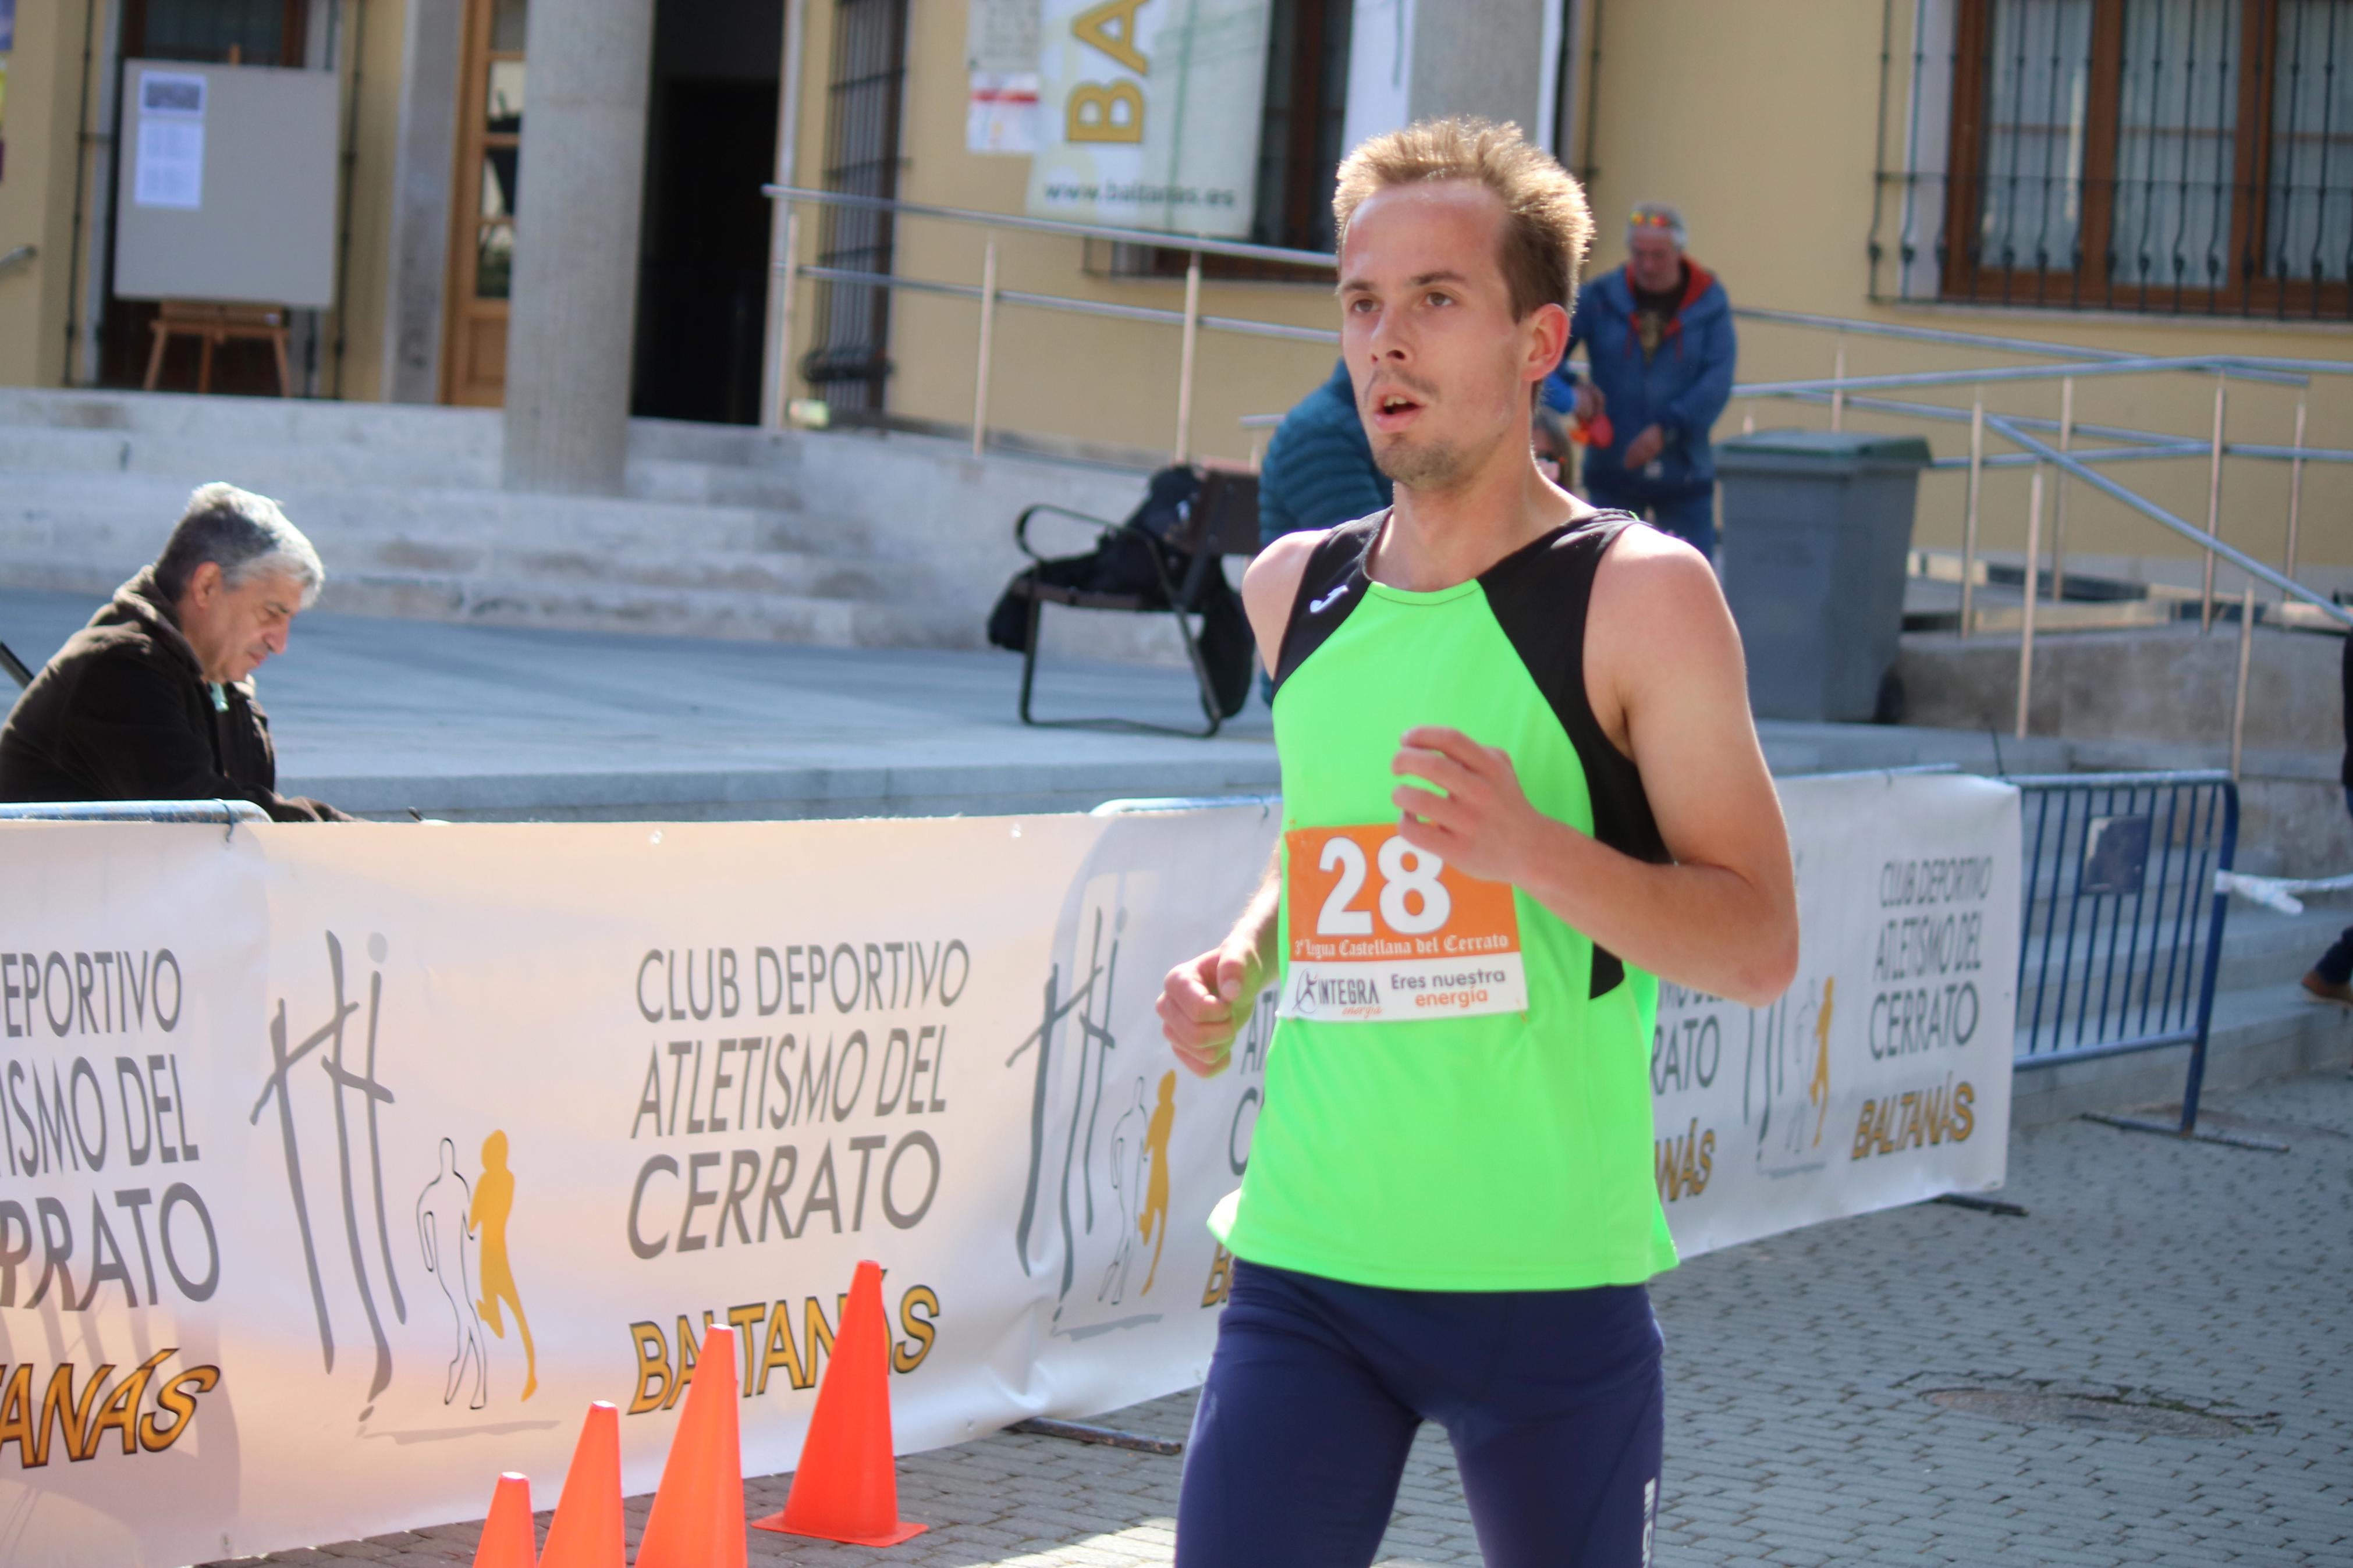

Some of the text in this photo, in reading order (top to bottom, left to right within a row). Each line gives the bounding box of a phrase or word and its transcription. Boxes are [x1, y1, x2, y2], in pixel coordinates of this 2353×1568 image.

[1316, 834, 1451, 936] 28
[636, 938, 971, 1023] CLUB DEPORTIVO
[1339, 938, 1412, 958] Castellana
[1415, 937, 1439, 954] del
[1443, 933, 1509, 952] Cerrato
[1392, 973, 1426, 990] Eres
[1432, 968, 1506, 987] nuestra
[1, 948, 182, 1038] EPORTIVO
[1414, 984, 1488, 1008] energía
[1869, 980, 1979, 1061] CERRATO
[116, 1054, 200, 1165] DEL
[631, 1025, 947, 1139] ATLETISMO DEL
[1851, 1070, 1975, 1160] BALTANÁS
[627, 1130, 941, 1260] CERRATO
[626, 1268, 941, 1416] BATANS
[0, 1348, 221, 1469] ANÁS
